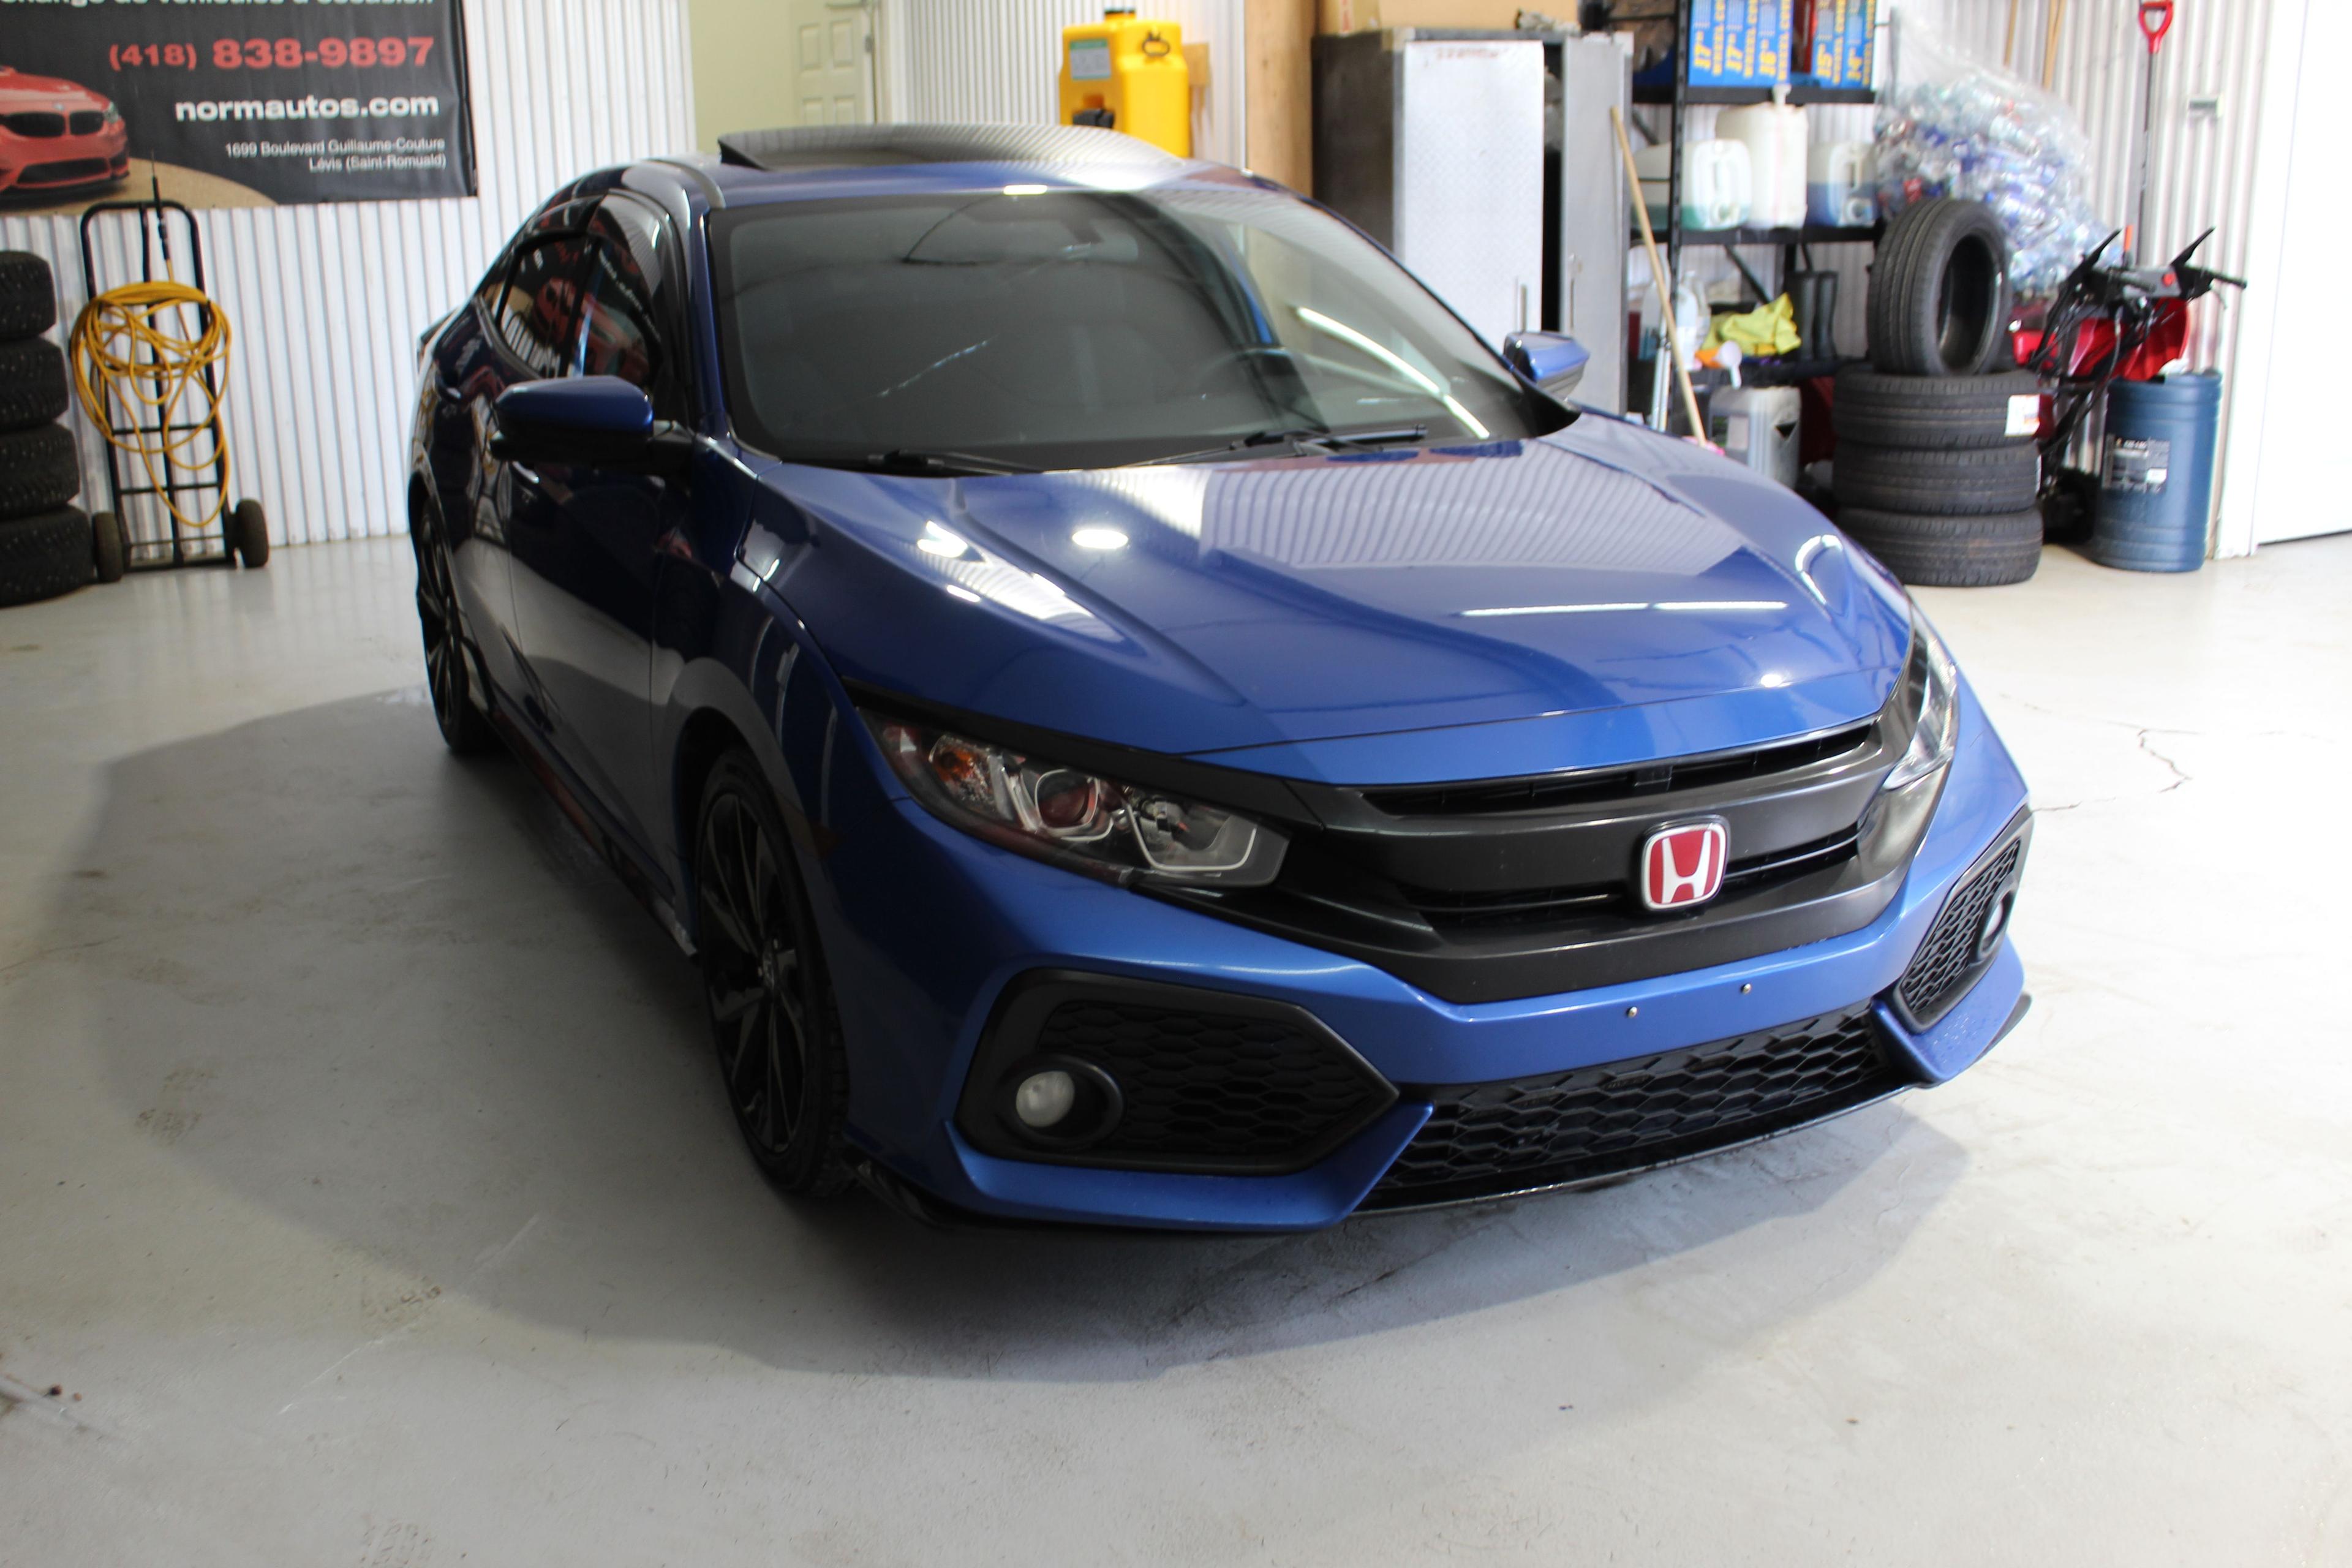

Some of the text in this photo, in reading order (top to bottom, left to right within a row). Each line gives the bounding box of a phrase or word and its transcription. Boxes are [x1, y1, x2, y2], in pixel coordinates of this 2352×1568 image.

[109, 36, 434, 71] (418) 838-9897
[175, 94, 439, 122] normautos.com
[260, 139, 325, 157] Boulevard
[328, 136, 445, 154] Guillaume-Couture
[309, 153, 447, 175] Lévis (Saint-Romuald)
